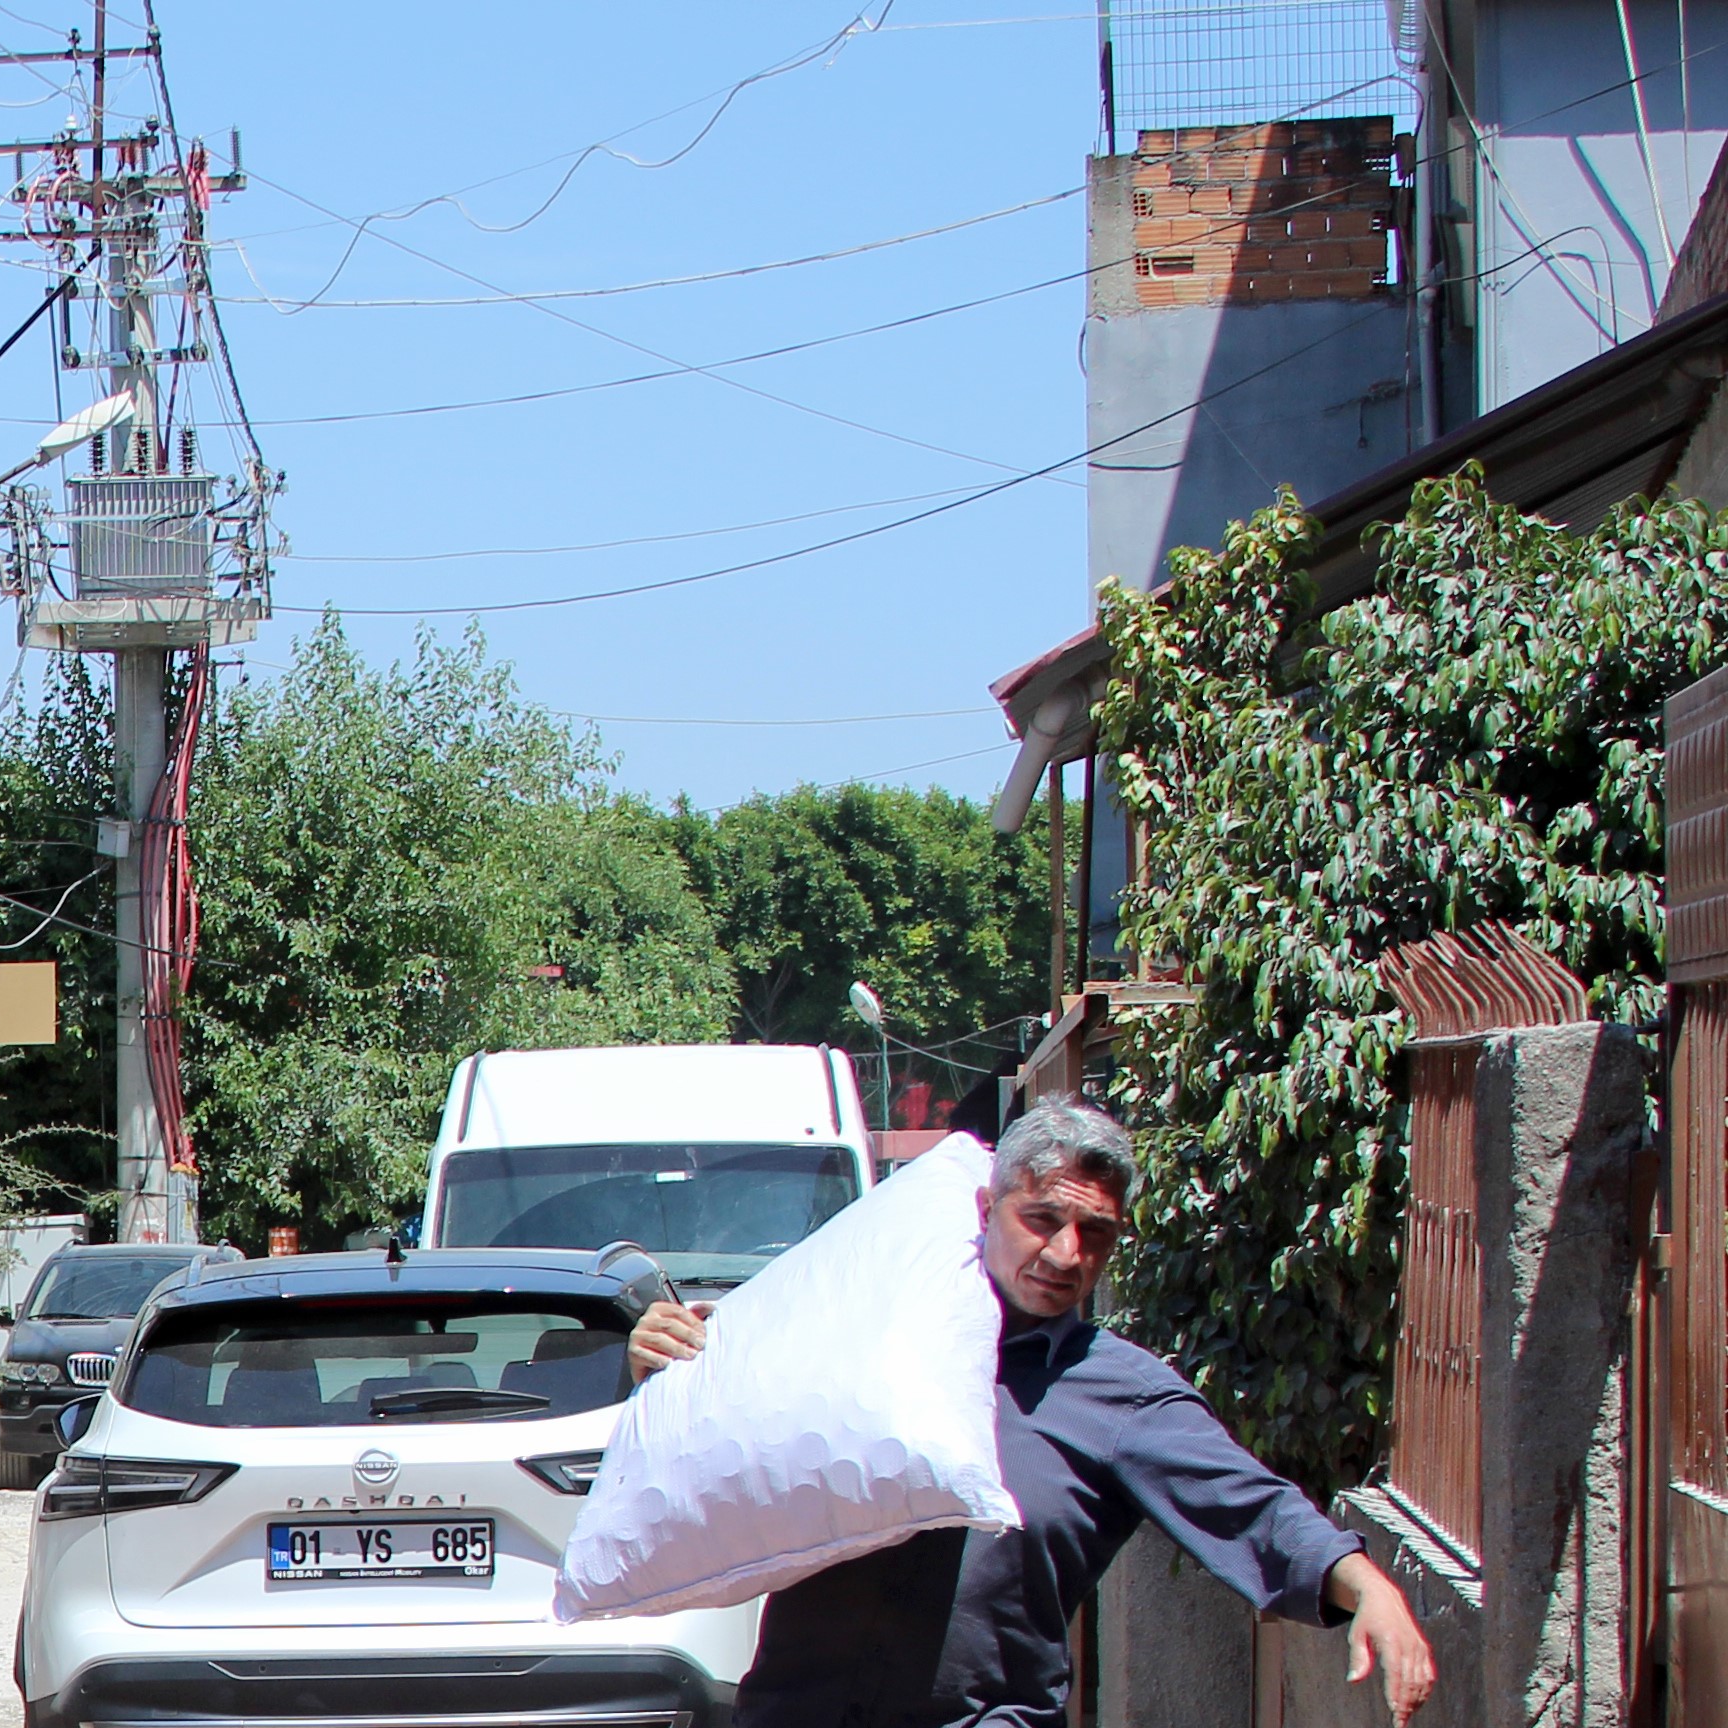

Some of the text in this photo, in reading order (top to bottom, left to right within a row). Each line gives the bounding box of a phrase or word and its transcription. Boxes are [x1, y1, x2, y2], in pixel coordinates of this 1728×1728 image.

[355, 1461, 398, 1470] NISSAN
[287, 1493, 467, 1508] QASHQAI
[289, 1527, 487, 1565] 01 YS 685
[273, 1550, 289, 1562] TR
[272, 1569, 323, 1579] NISSAN
[464, 1566, 489, 1576] Okar
